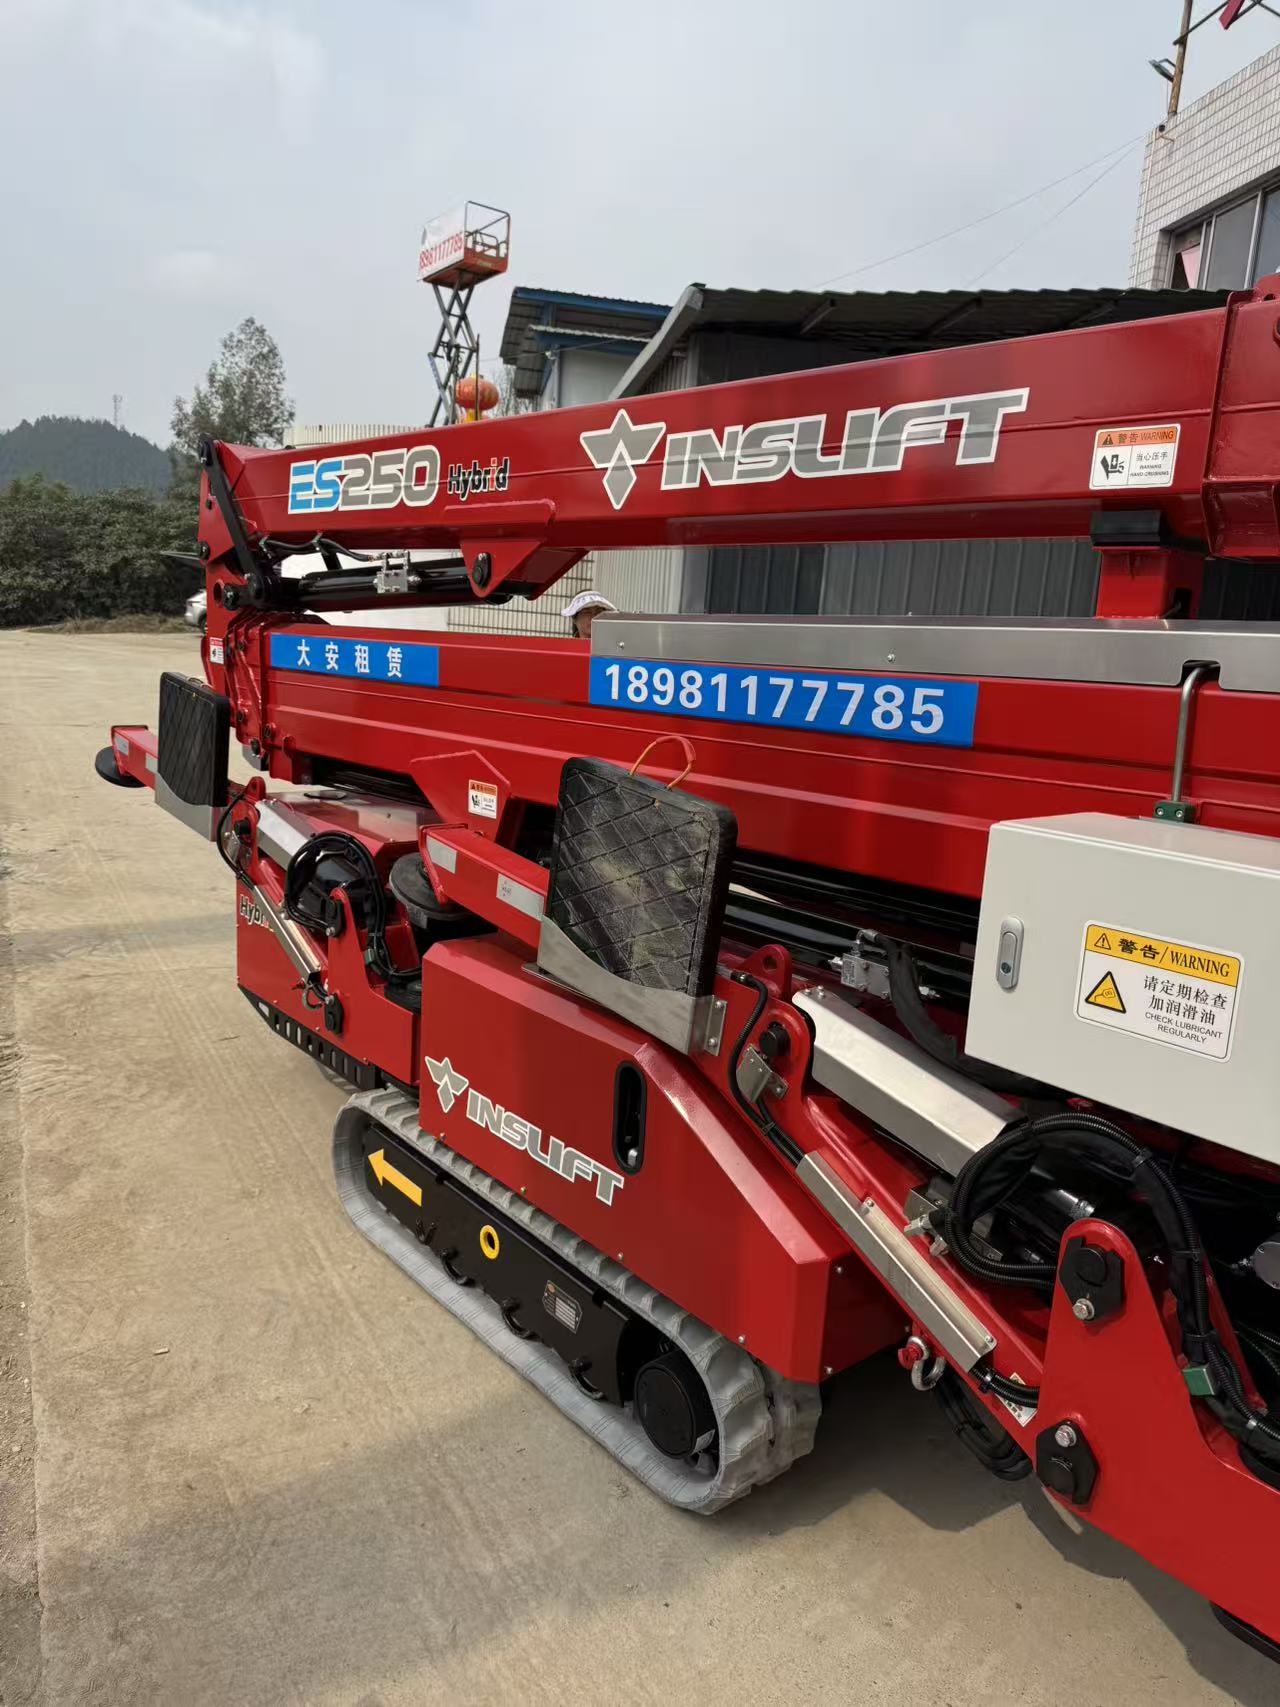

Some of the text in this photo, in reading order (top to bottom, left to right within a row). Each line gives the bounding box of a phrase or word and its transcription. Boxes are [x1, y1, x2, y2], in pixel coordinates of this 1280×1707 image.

[661, 387, 1030, 490] INSLIFT
[1140, 430, 1174, 441] WARNING
[288, 445, 509, 514] ES250 Hybrid
[297, 639, 403, 679] 大安租赁
[605, 664, 945, 734] 18981177785
[1143, 975, 1227, 1010] 请定期检查
[1150, 994, 1215, 1026] 加润滑油
[1145, 1011, 1223, 1039] CHECK LUBRICANT
[1157, 1023, 1207, 1044] REGULARLY
[466, 1088, 625, 1207] INSLIFT
